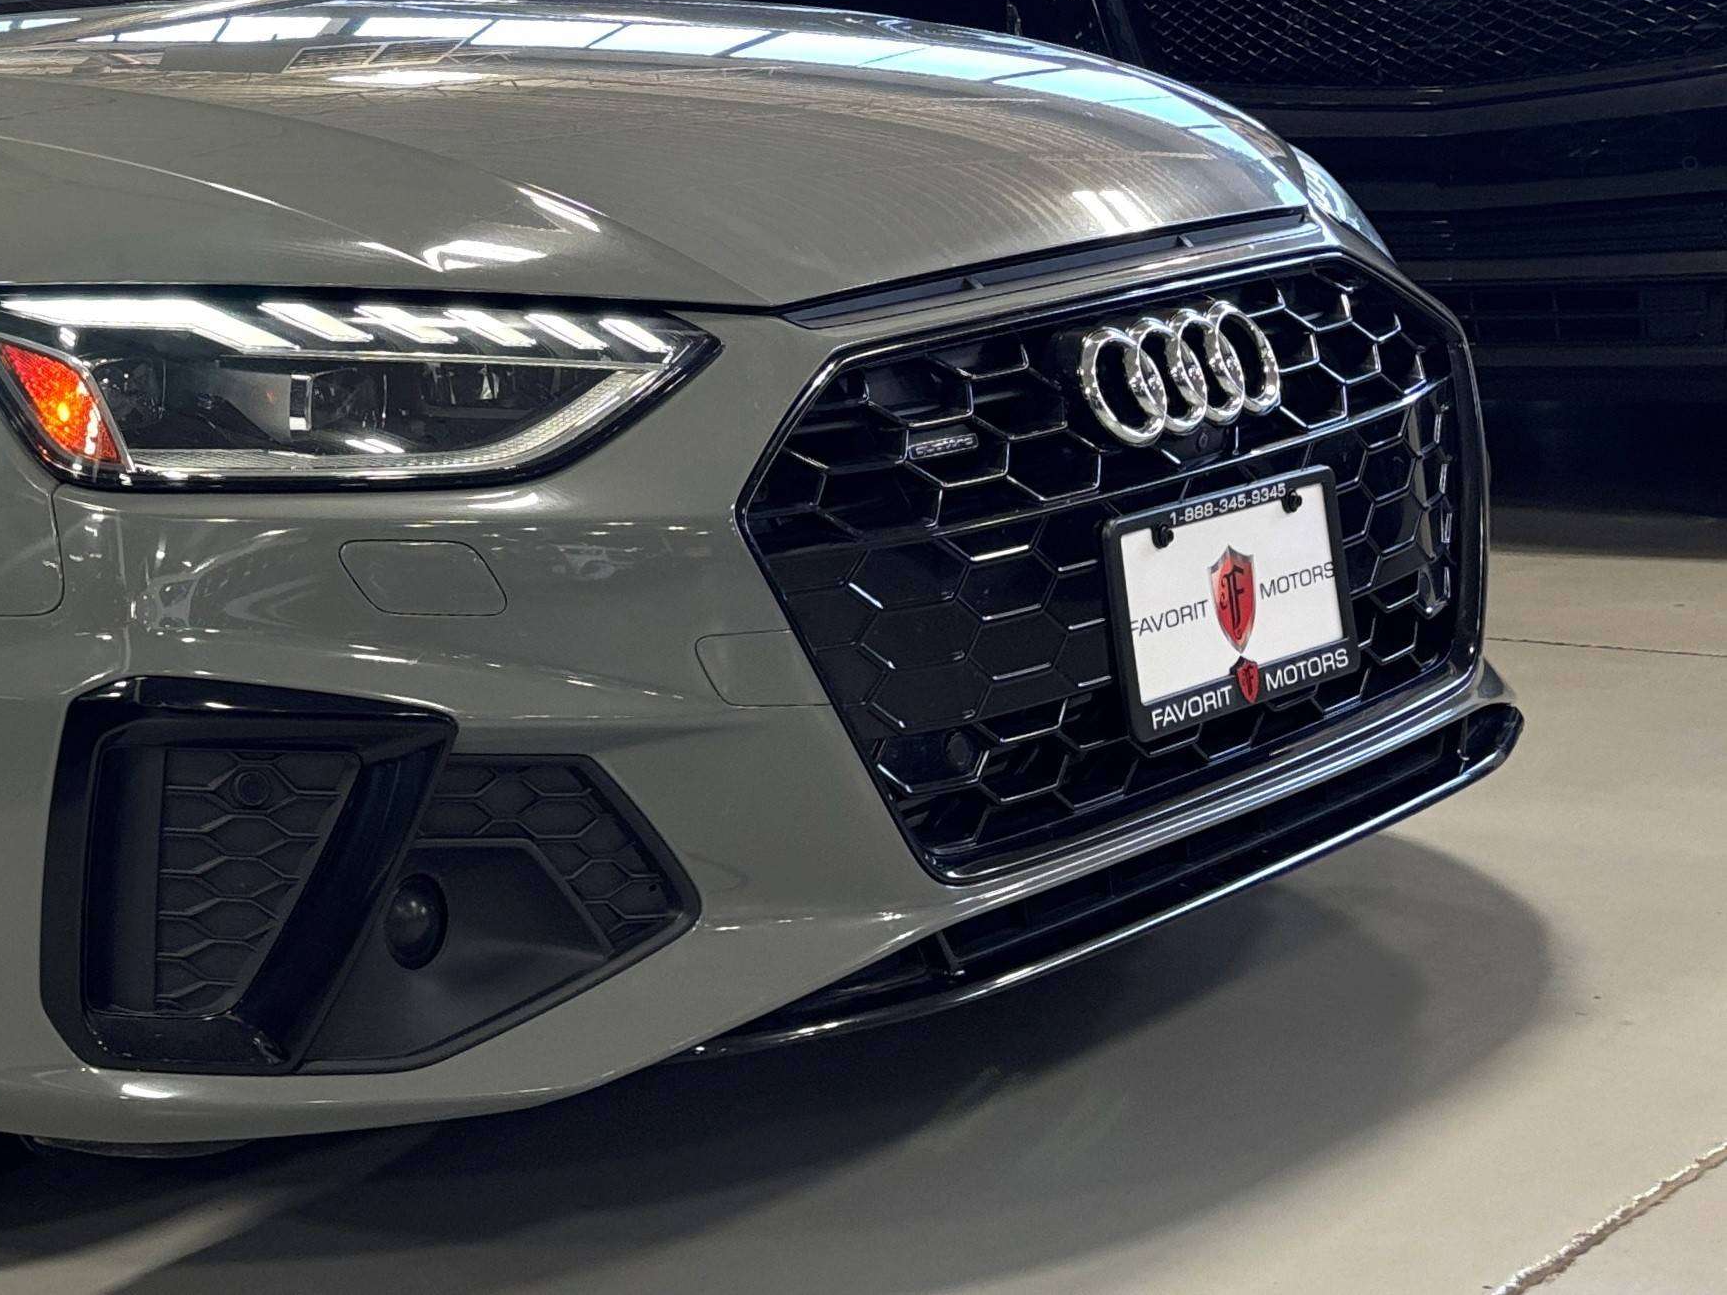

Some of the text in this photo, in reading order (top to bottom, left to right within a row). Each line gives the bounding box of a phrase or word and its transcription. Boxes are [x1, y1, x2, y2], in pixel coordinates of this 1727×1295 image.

[1169, 482, 1287, 526] 1-888-345-9345
[1259, 561, 1334, 600] MOTORS
[1151, 685, 1233, 731] FAVORIT
[1265, 648, 1349, 691] MOTORS
